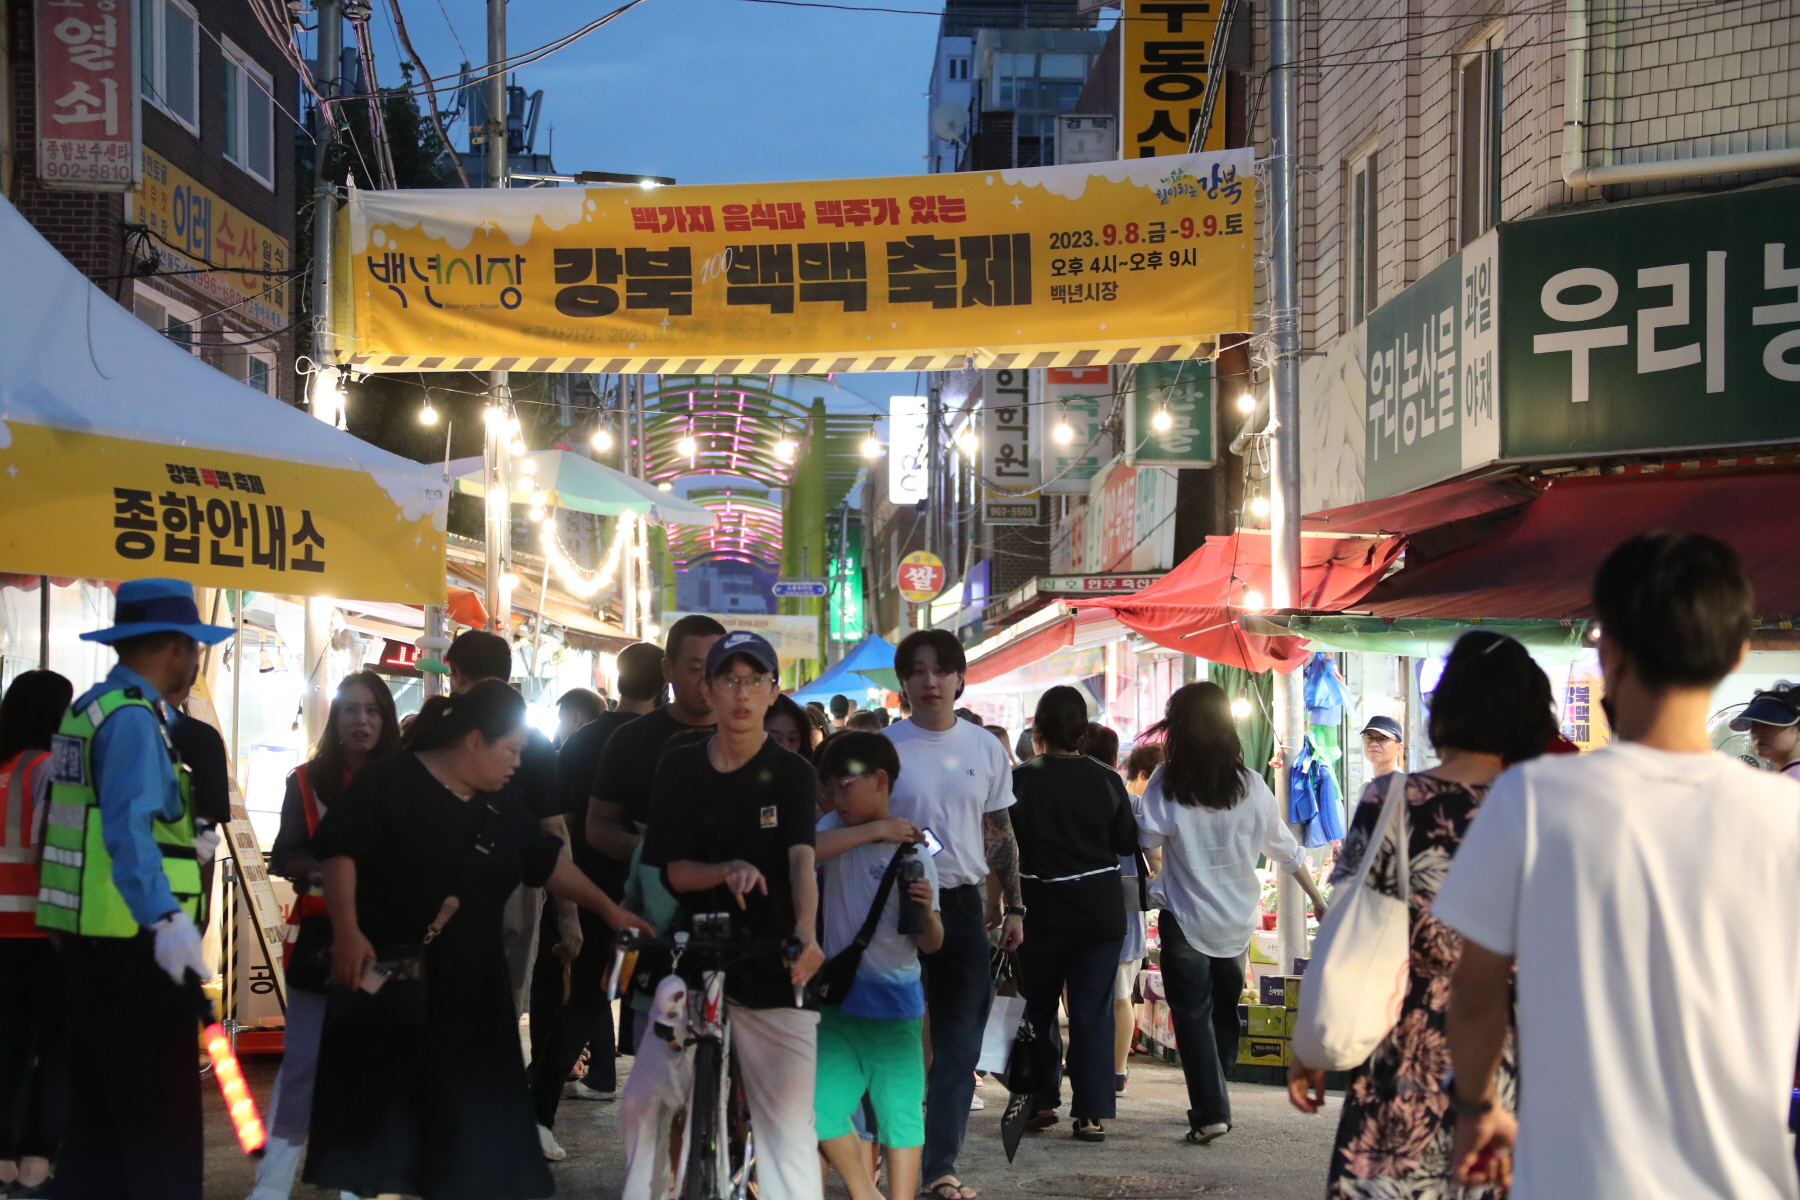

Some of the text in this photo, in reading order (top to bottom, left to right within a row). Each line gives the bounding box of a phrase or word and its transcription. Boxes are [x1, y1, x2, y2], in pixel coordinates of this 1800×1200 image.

[52, 14, 118, 136] 열쇠
[46, 141, 130, 164] 종합보수센타
[47, 163, 129, 181] 902-5810
[1197, 163, 1243, 205] 강북
[631, 195, 967, 234] 백가지 음식과 맥주가 있는
[553, 232, 1033, 318] 강북 백맥 축제
[1051, 257, 1084, 277] 오후
[1169, 248, 1198, 268] 9시
[1050, 281, 1119, 305] 백년시장
[1465, 256, 1492, 340] 과일
[1369, 305, 1457, 461] 우리농산물
[1465, 350, 1493, 428] 야채
[165, 463, 201, 487] 강북
[233, 472, 267, 496] 축제
[113, 487, 326, 573] 종합안내소
[904, 565, 938, 591] 쌀
